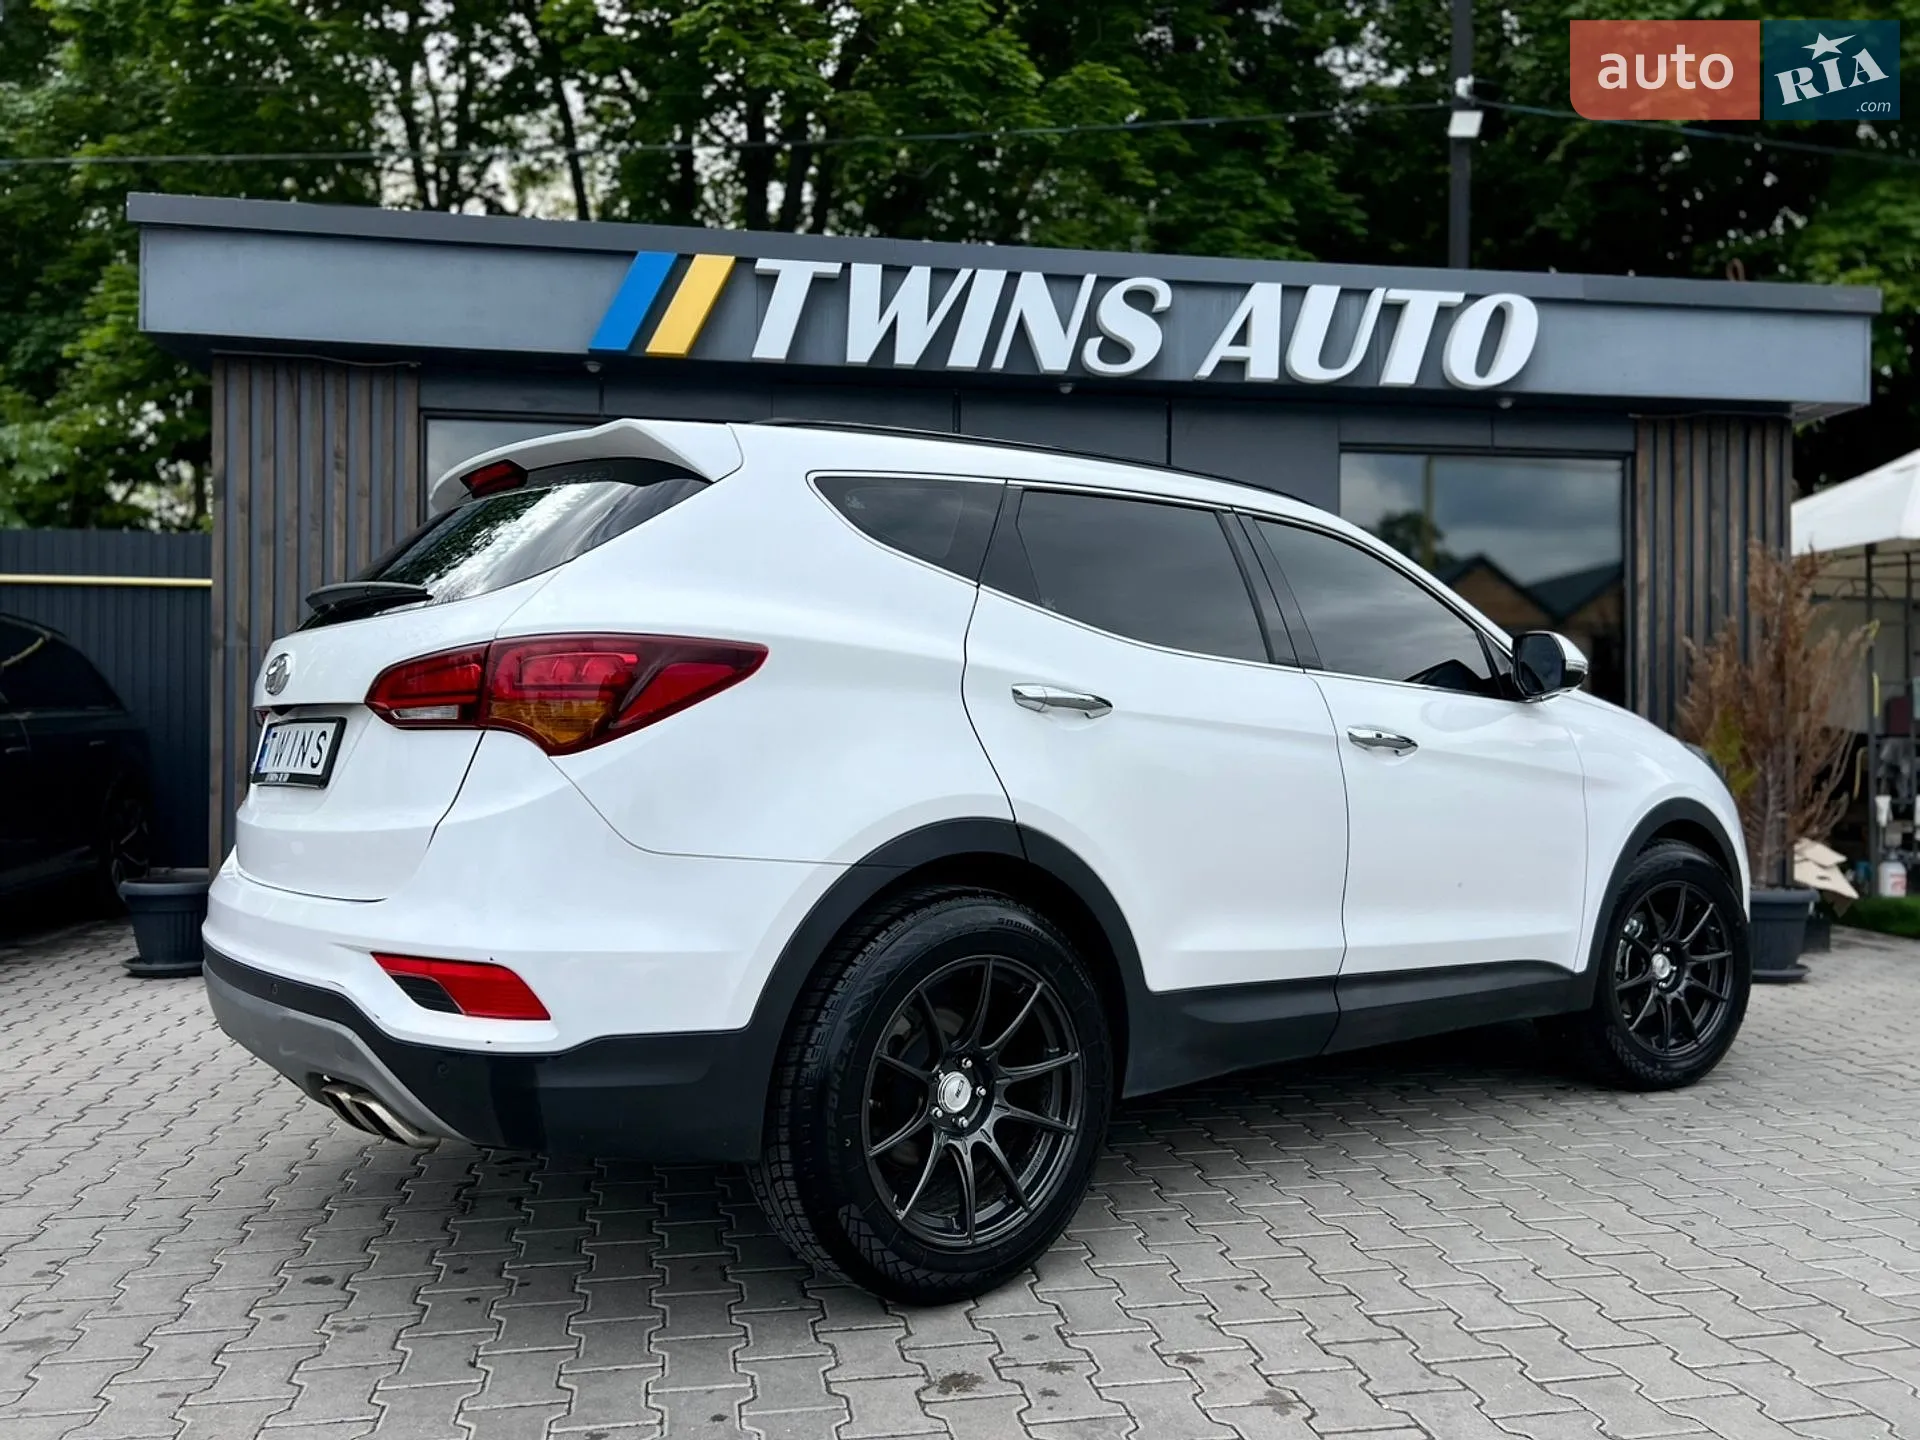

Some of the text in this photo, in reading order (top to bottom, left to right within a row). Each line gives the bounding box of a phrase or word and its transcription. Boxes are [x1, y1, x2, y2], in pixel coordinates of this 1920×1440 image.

[751, 257, 1539, 390] TWINS AUTO
[264, 730, 327, 769] TWINS
